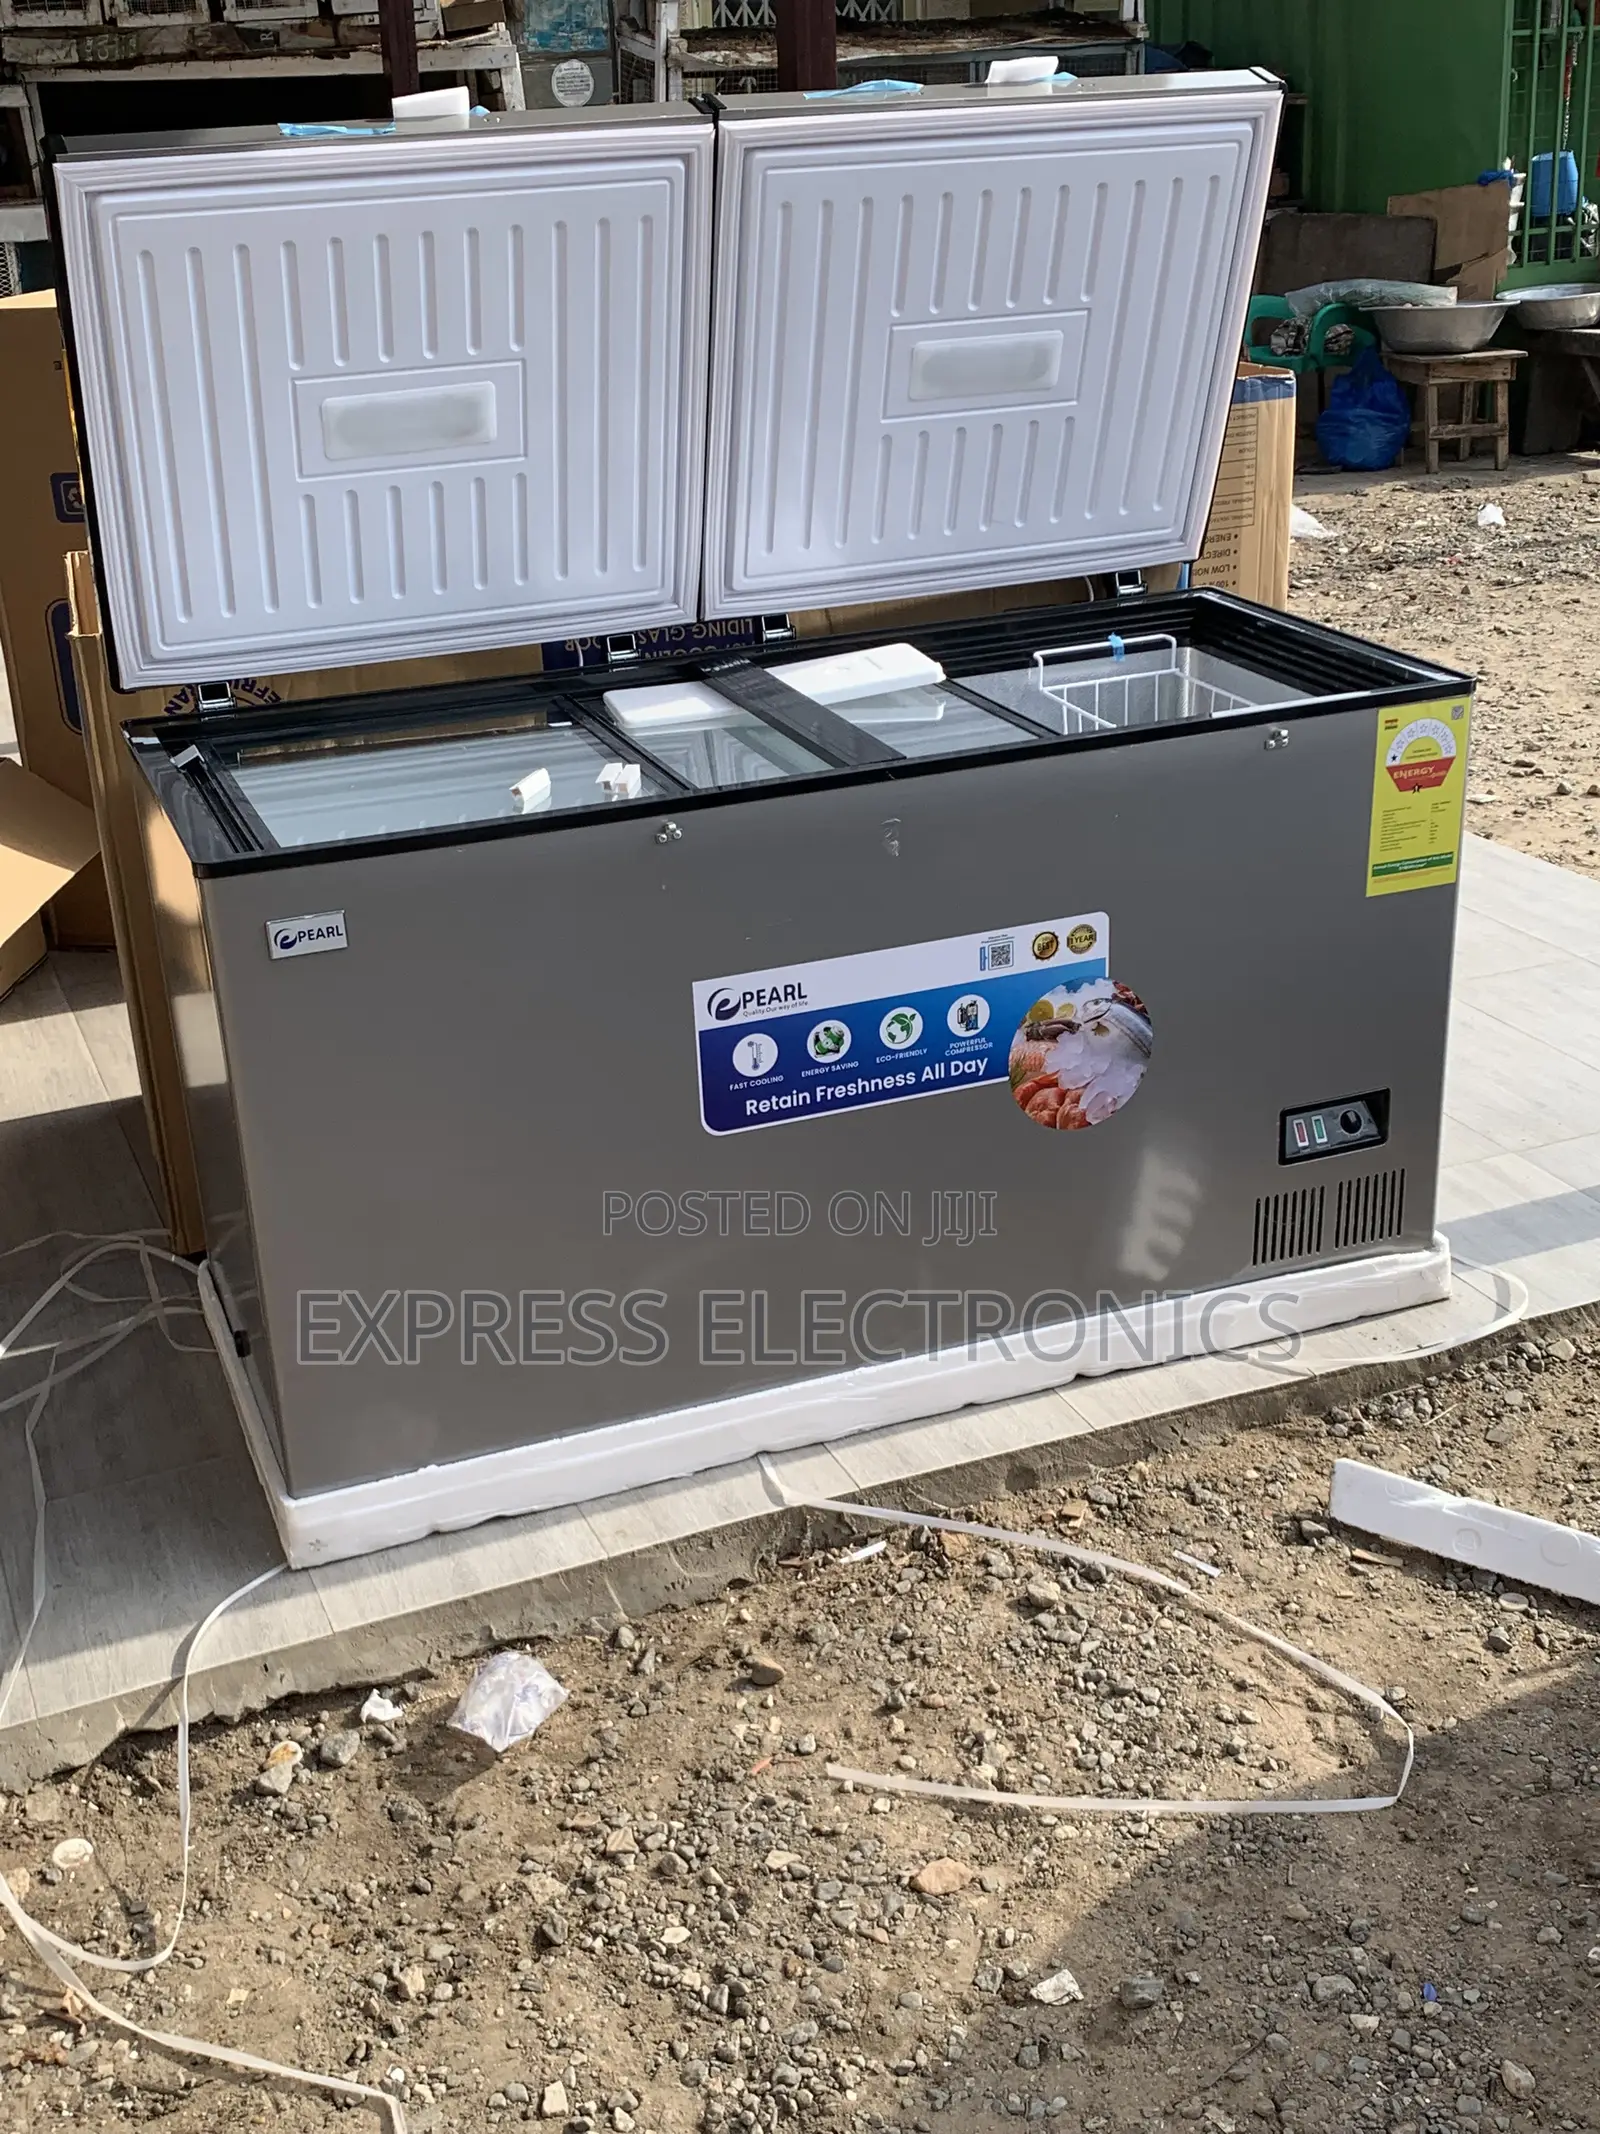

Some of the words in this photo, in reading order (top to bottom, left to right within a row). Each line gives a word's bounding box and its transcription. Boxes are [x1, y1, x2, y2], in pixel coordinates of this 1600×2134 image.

[298, 925, 344, 943] PEARL
[1075, 934, 1094, 944] YEAR
[742, 982, 808, 1009] PEARL
[944, 1042, 993, 1056] COMPRESSOR
[949, 1037, 986, 1049] POWERFUL
[876, 1048, 928, 1064] ECO-FRIENDLY
[801, 1065, 830, 1077] ENERGY
[830, 1061, 859, 1072] SAVING
[729, 1080, 749, 1091] FAST
[749, 1075, 784, 1087] COOLING
[745, 1089, 811, 1115] Retain
[816, 1072, 916, 1102] Freshness
[921, 1063, 945, 1082] All
[950, 1057, 988, 1077] Day
